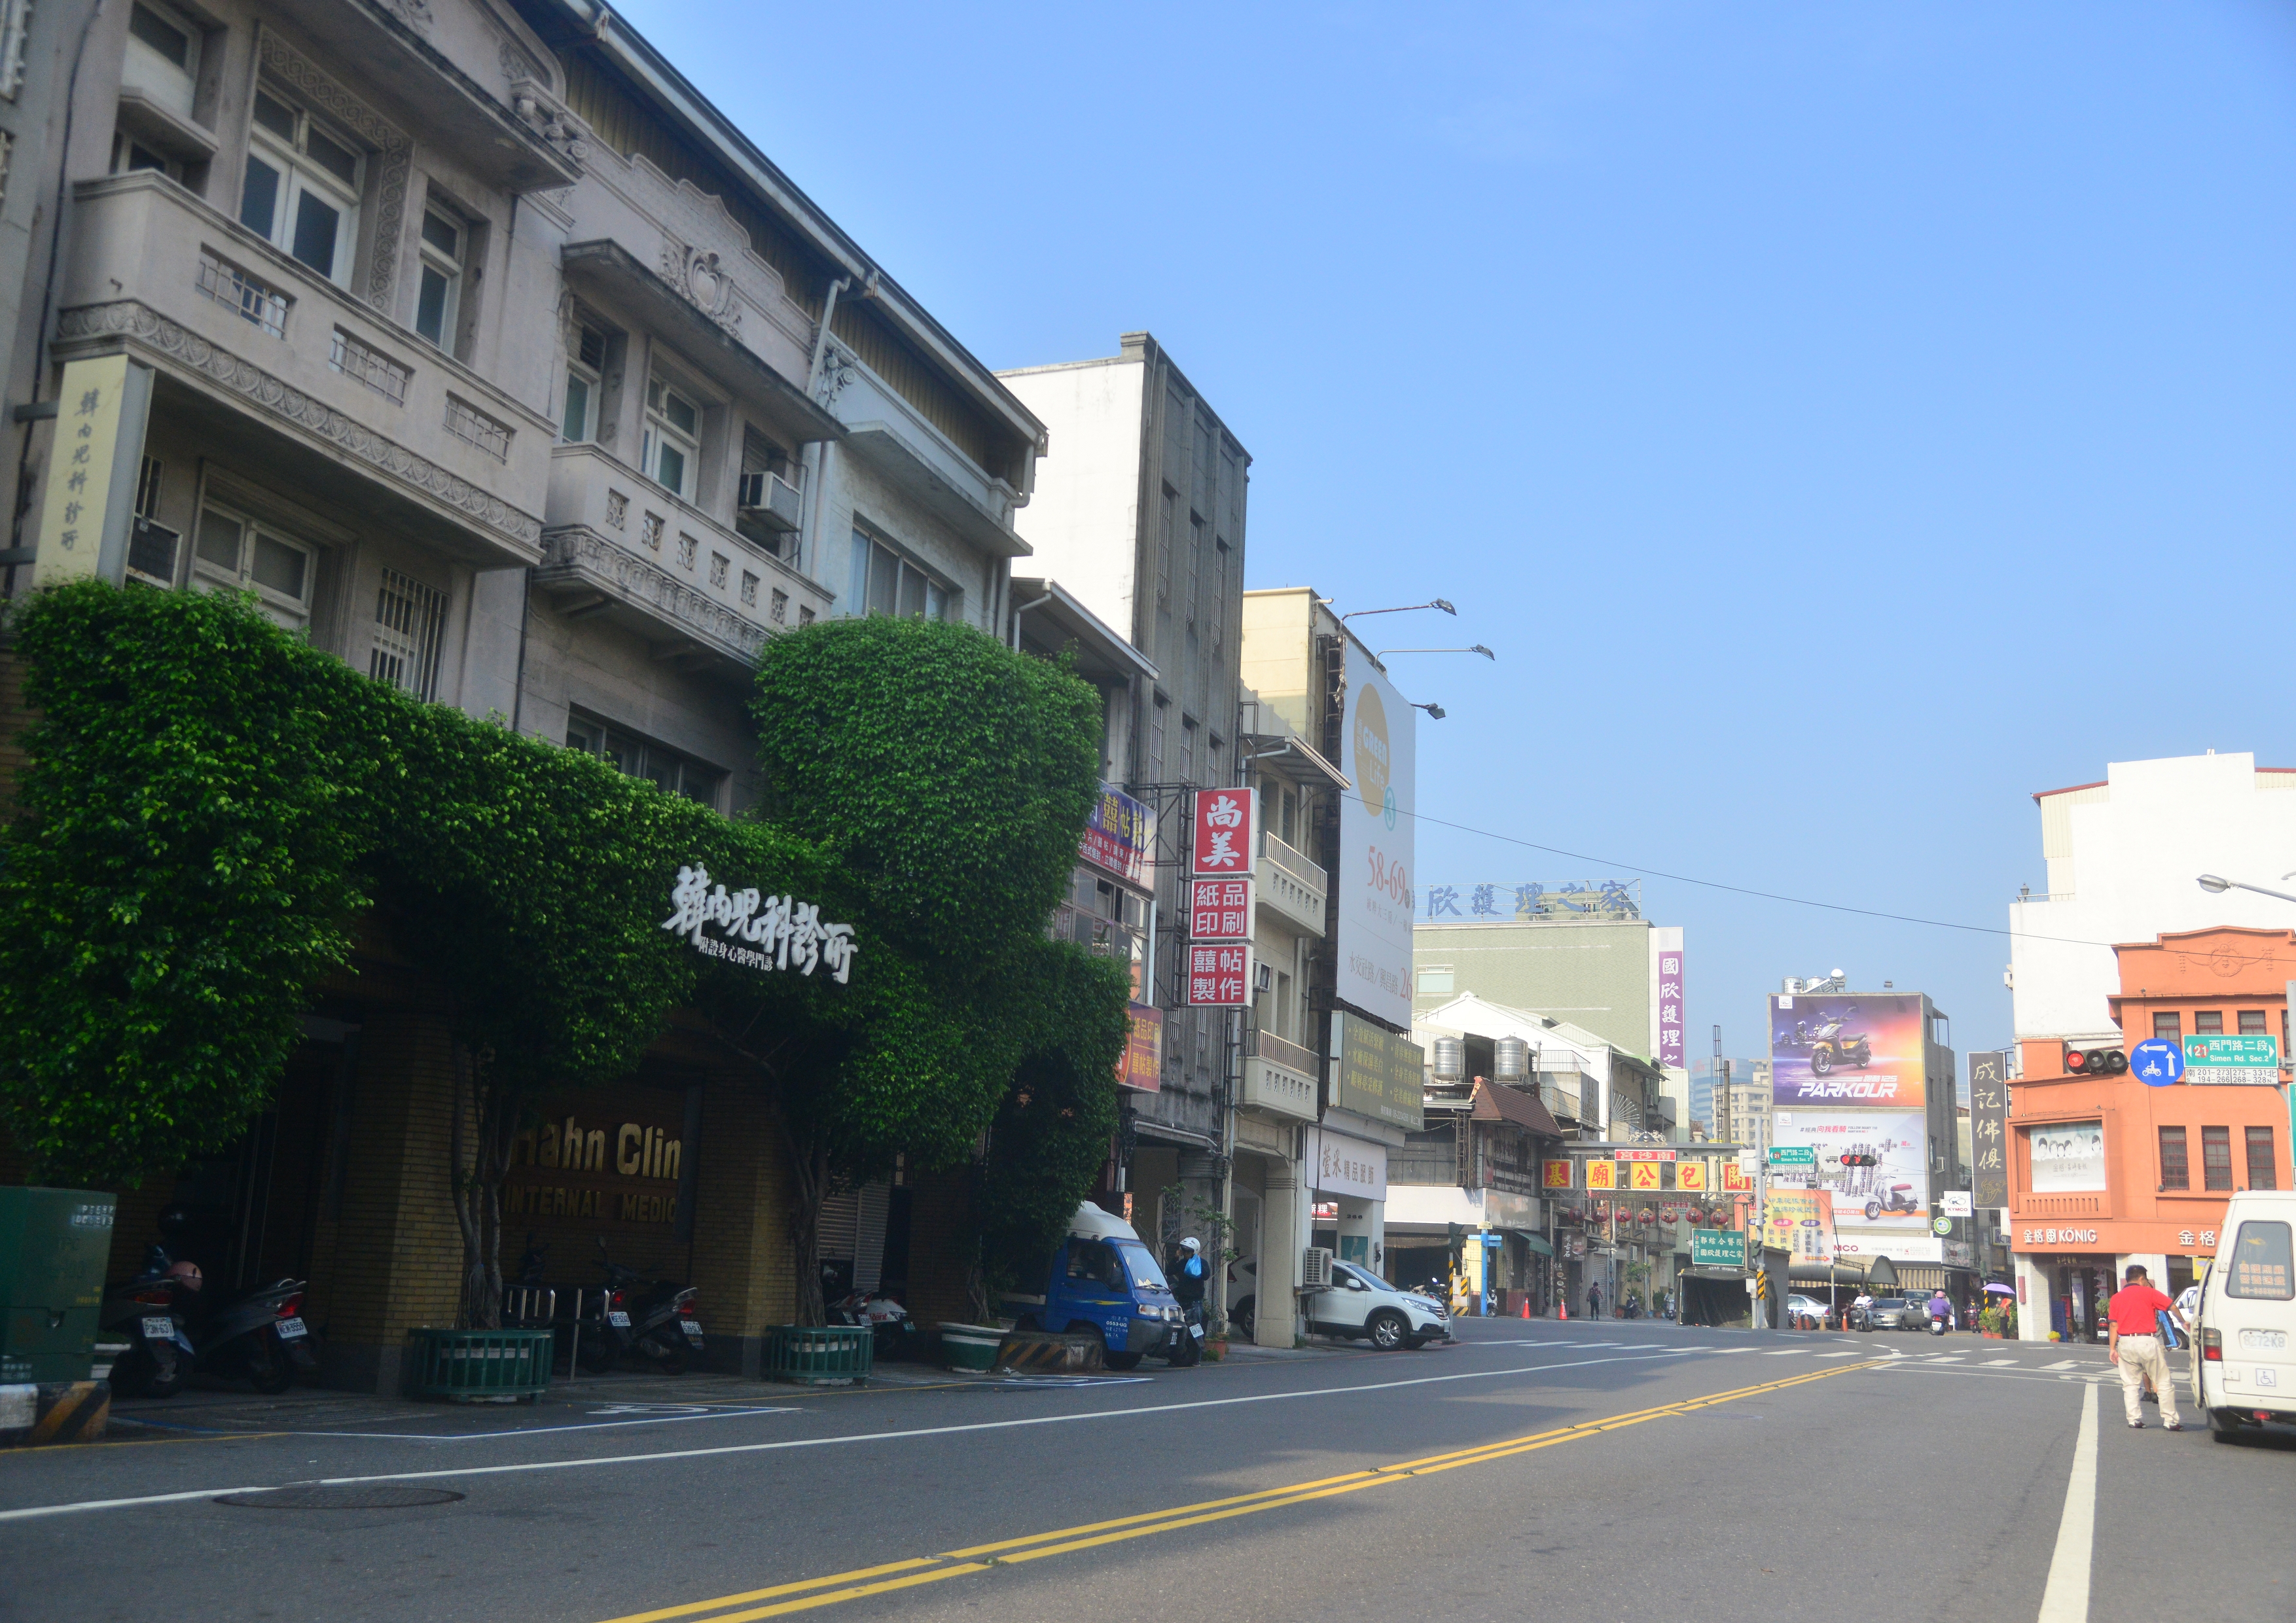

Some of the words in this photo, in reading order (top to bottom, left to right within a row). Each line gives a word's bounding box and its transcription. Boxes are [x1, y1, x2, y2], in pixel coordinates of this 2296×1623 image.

[1370, 759, 1384, 791] Life
[1202, 795, 1243, 867] 尚美
[1367, 845, 1406, 906] 58-69
[1196, 885, 1245, 906] 紙品
[1413, 880, 1630, 917] 欣護理之家
[1195, 912, 1244, 934] 印刷
[698, 935, 773, 972] 附設身心醫學門診
[1194, 950, 1242, 972] 囍帖
[1193, 977, 1242, 1001] 製作
[1133, 1016, 1160, 1046] 紙品印刷
[2194, 1045, 2206, 1056] 21
[2209, 1039, 2268, 1052] 西門路二段
[1797, 1082, 1897, 1098] PARKOUR
[1350, 1159, 1380, 1185] 精品服飾
[505, 1184, 606, 1219] INTERNAL
[1700, 1236, 1744, 1246] 郭綜合醫院
[2023, 1229, 2044, 1243] 金格
[2058, 1227, 2097, 1243] KÖNIG
[2178, 1230, 2215, 1246] 金格
[1700, 1249, 1744, 1258] 國欣護理之家
